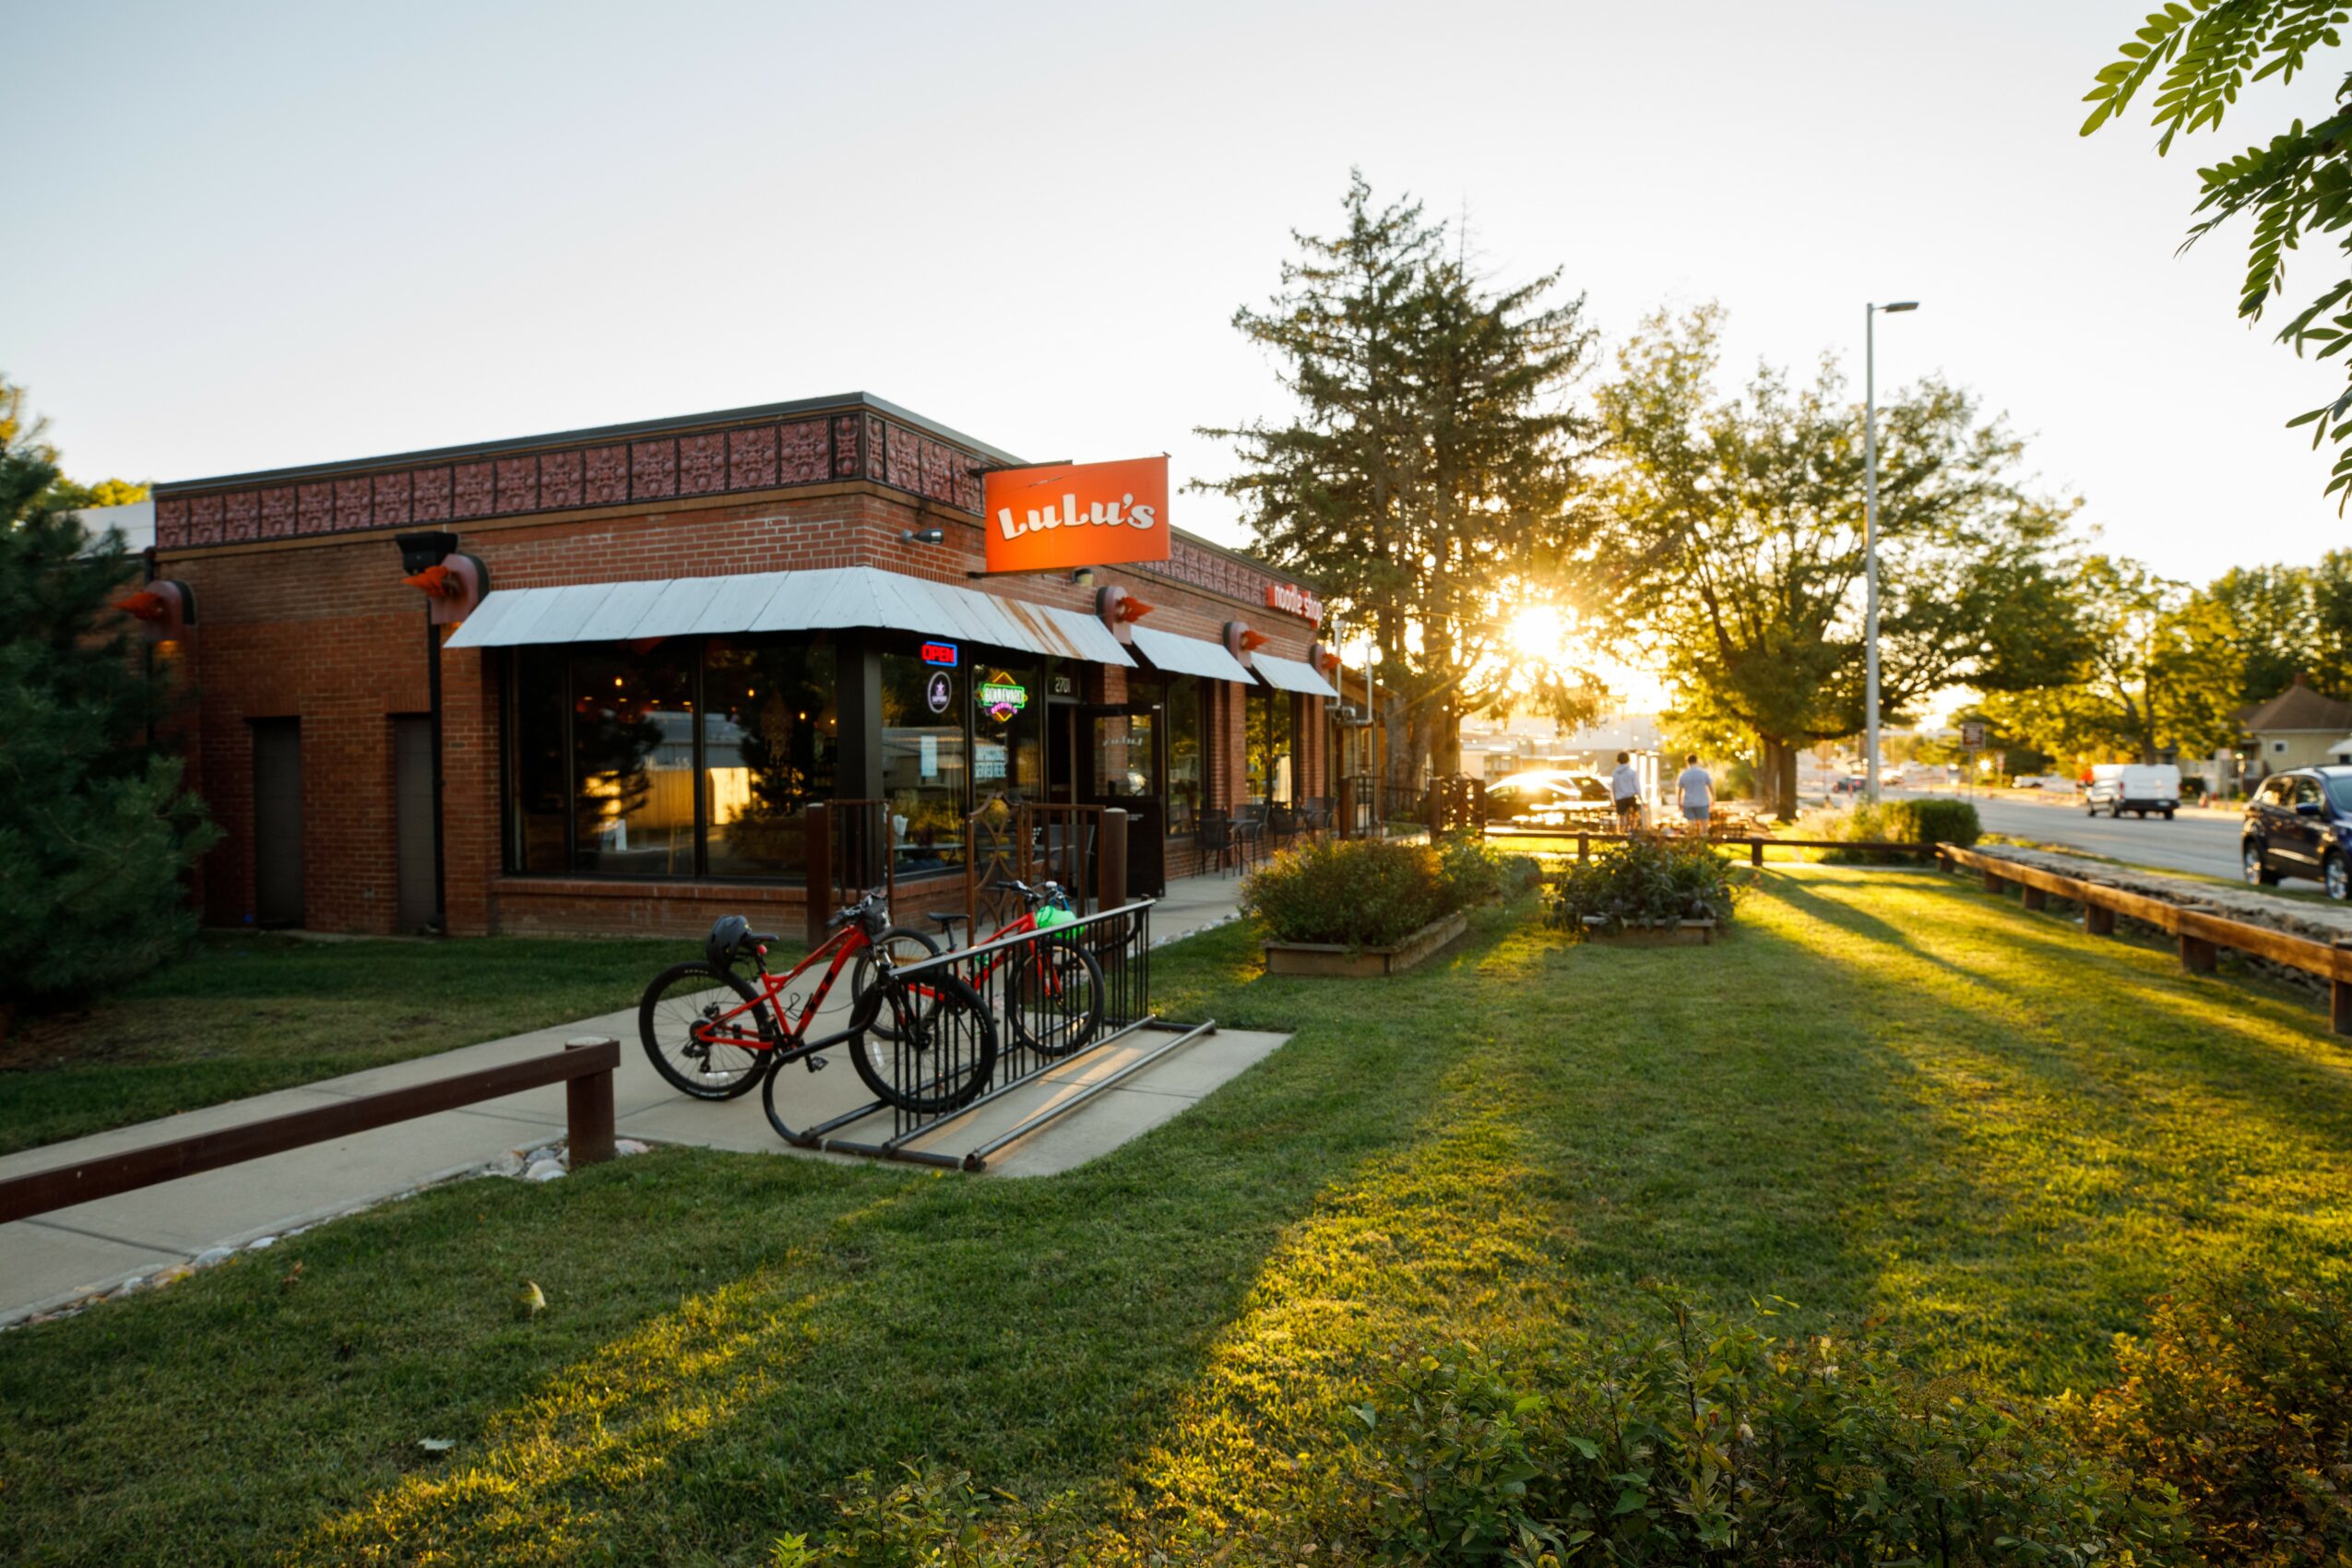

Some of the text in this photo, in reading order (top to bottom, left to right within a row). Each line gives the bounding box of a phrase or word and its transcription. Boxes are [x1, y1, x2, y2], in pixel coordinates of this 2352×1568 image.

[997, 493, 1156, 540] LuLu's
[1273, 584, 1324, 629] noodle shop
[921, 645, 955, 662] OPEN
[1055, 677, 1071, 694] 2701
